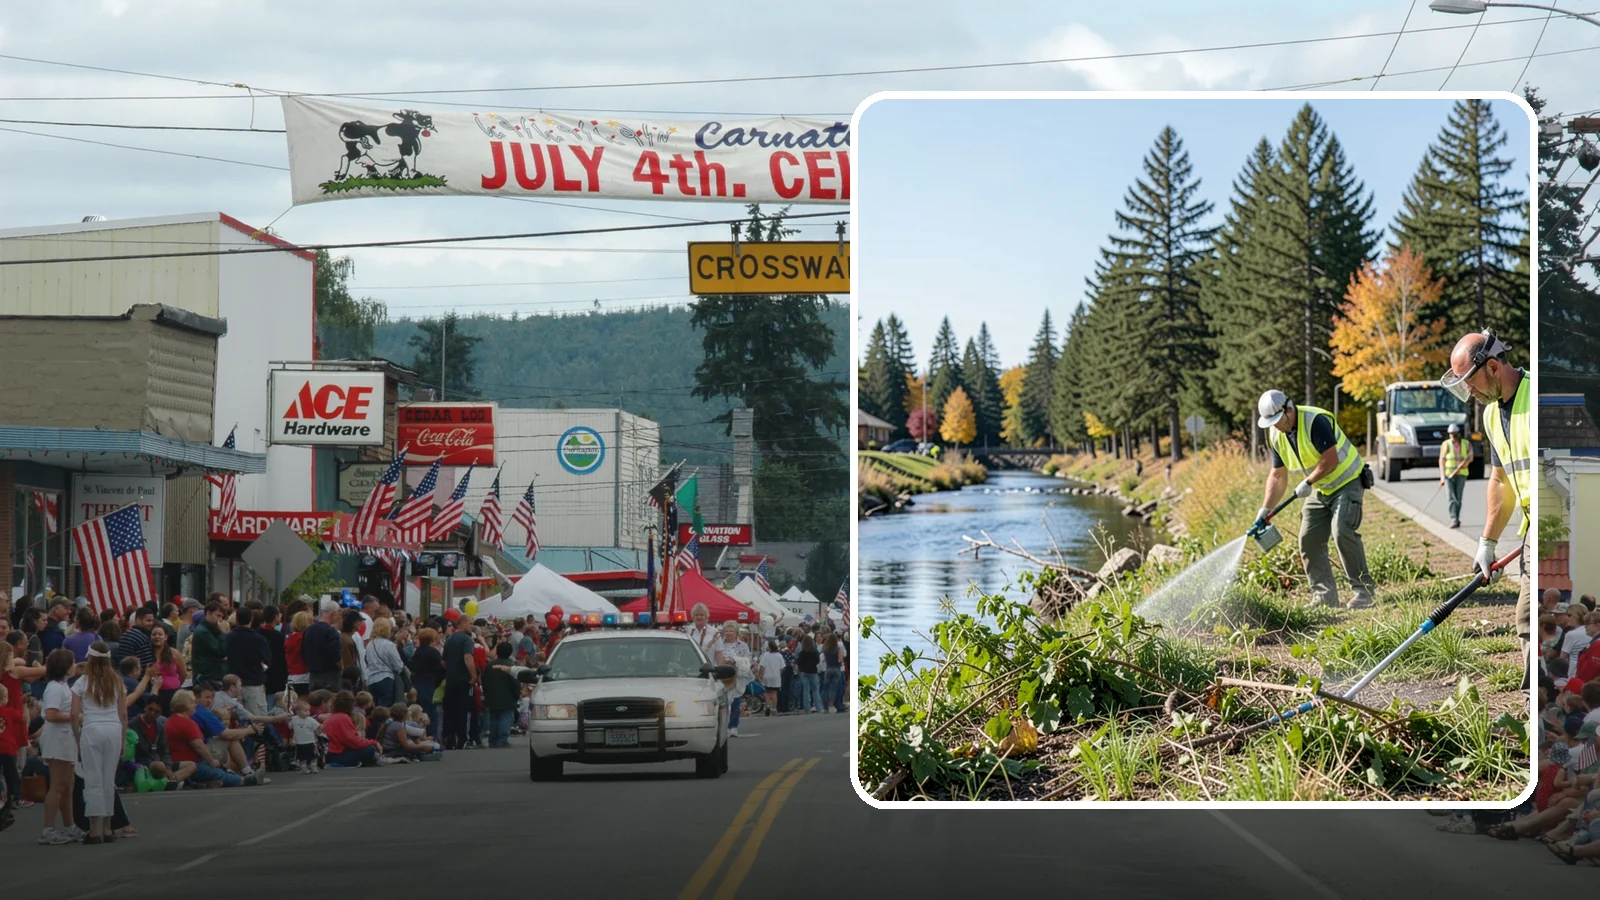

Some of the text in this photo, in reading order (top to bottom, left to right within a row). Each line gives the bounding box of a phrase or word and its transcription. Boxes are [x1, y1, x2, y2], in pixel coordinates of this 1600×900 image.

[481, 140, 605, 192] JULY
[632, 150, 747, 198] 4th.
[696, 254, 850, 281] CROSSWA
[283, 380, 374, 420] ACE
[405, 409, 485, 422] CEDAR LOG
[283, 421, 371, 437] Hardware
[416, 428, 476, 447] Coca-Cola
[354, 467, 387, 479] Simpl
[95, 485, 124, 495] Vincent
[126, 485, 136, 495] de
[137, 485, 155, 495] Paul
[81, 503, 154, 522] THRT
[212, 516, 331, 536] HARDARE
[688, 526, 741, 535] CRNATION
